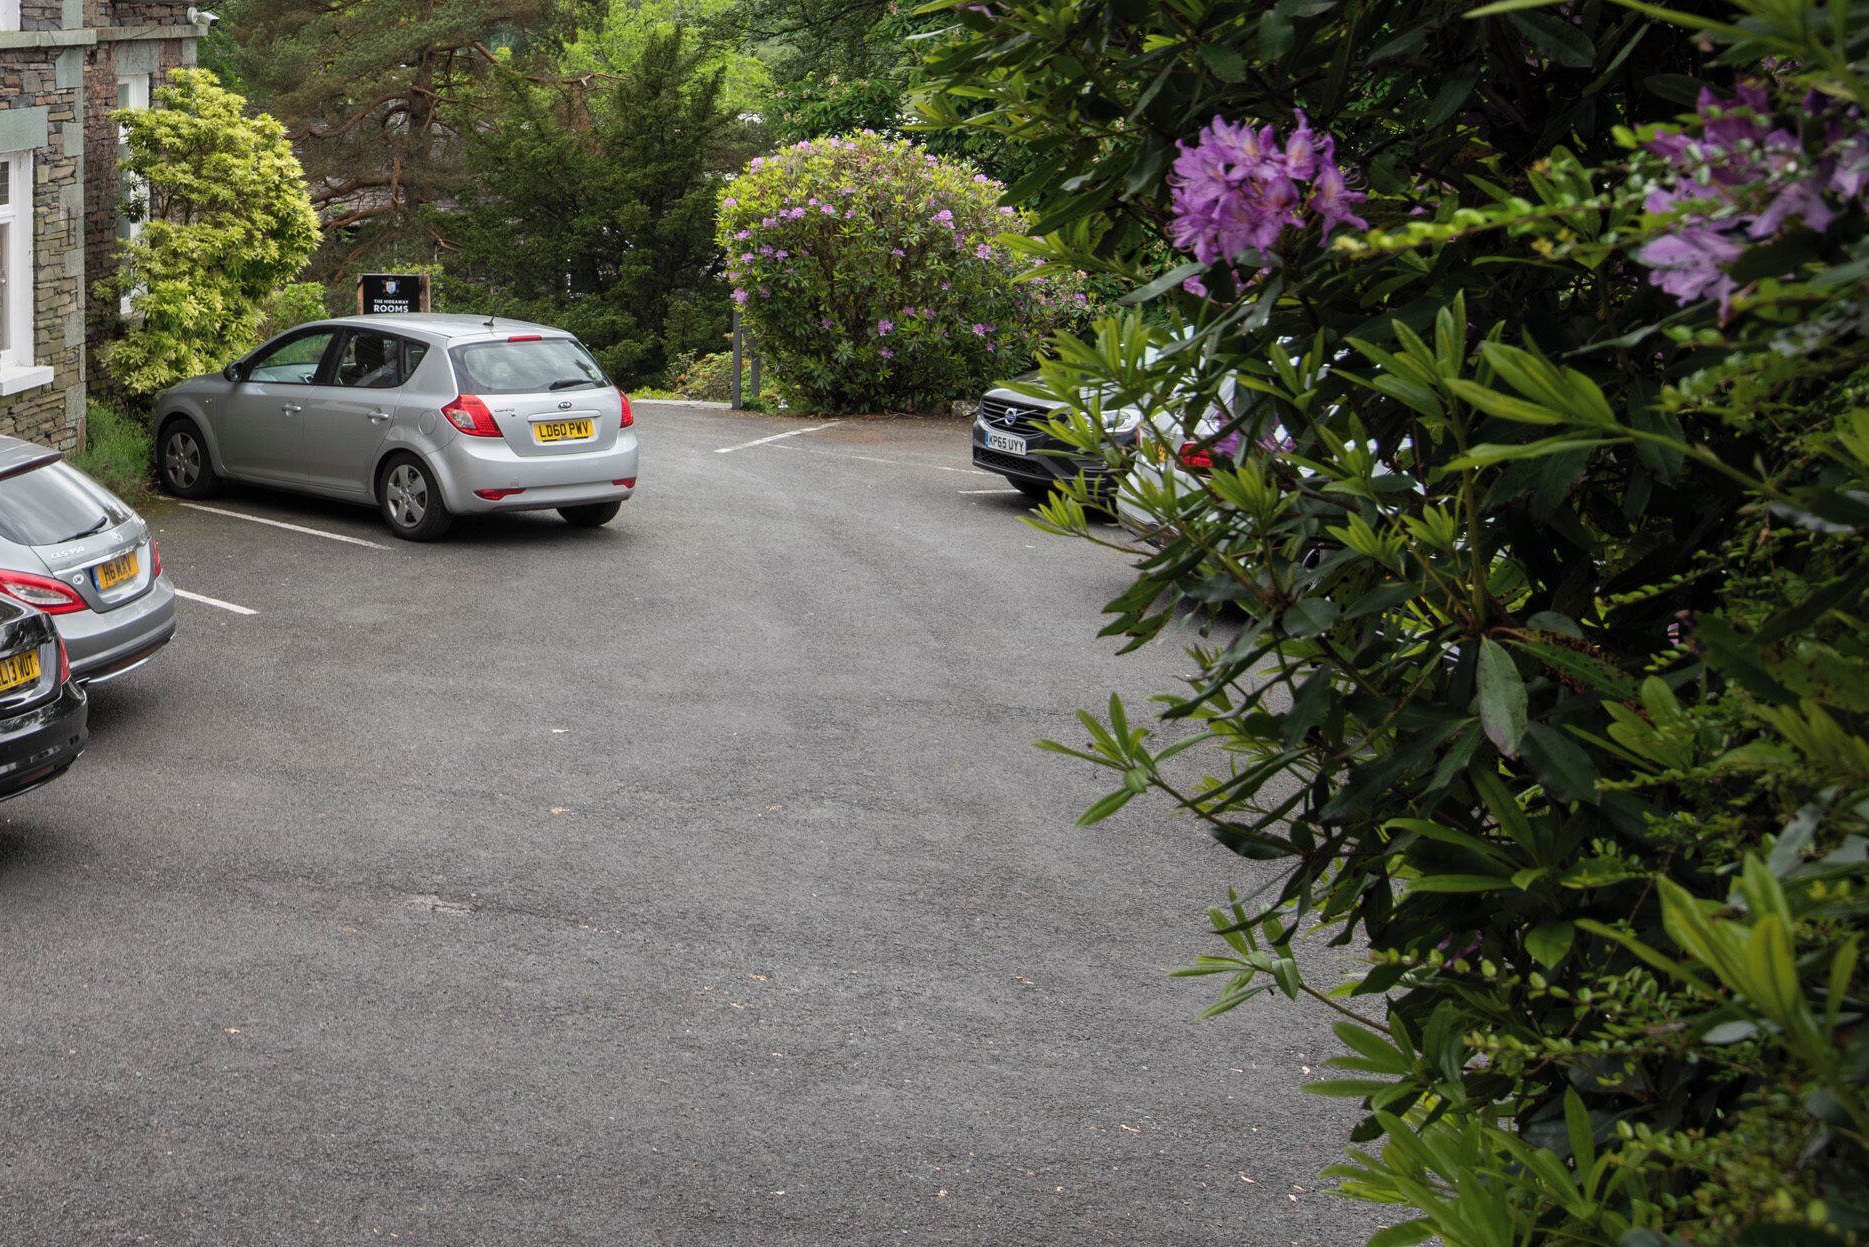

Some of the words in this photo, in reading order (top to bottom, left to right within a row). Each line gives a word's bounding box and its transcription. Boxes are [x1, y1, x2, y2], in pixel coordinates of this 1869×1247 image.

[373, 304, 409, 313] ROOMS
[538, 423, 567, 438] LD60
[569, 421, 589, 435] PWV
[989, 433, 1007, 449] KP65
[1008, 437, 1024, 452] UYY
